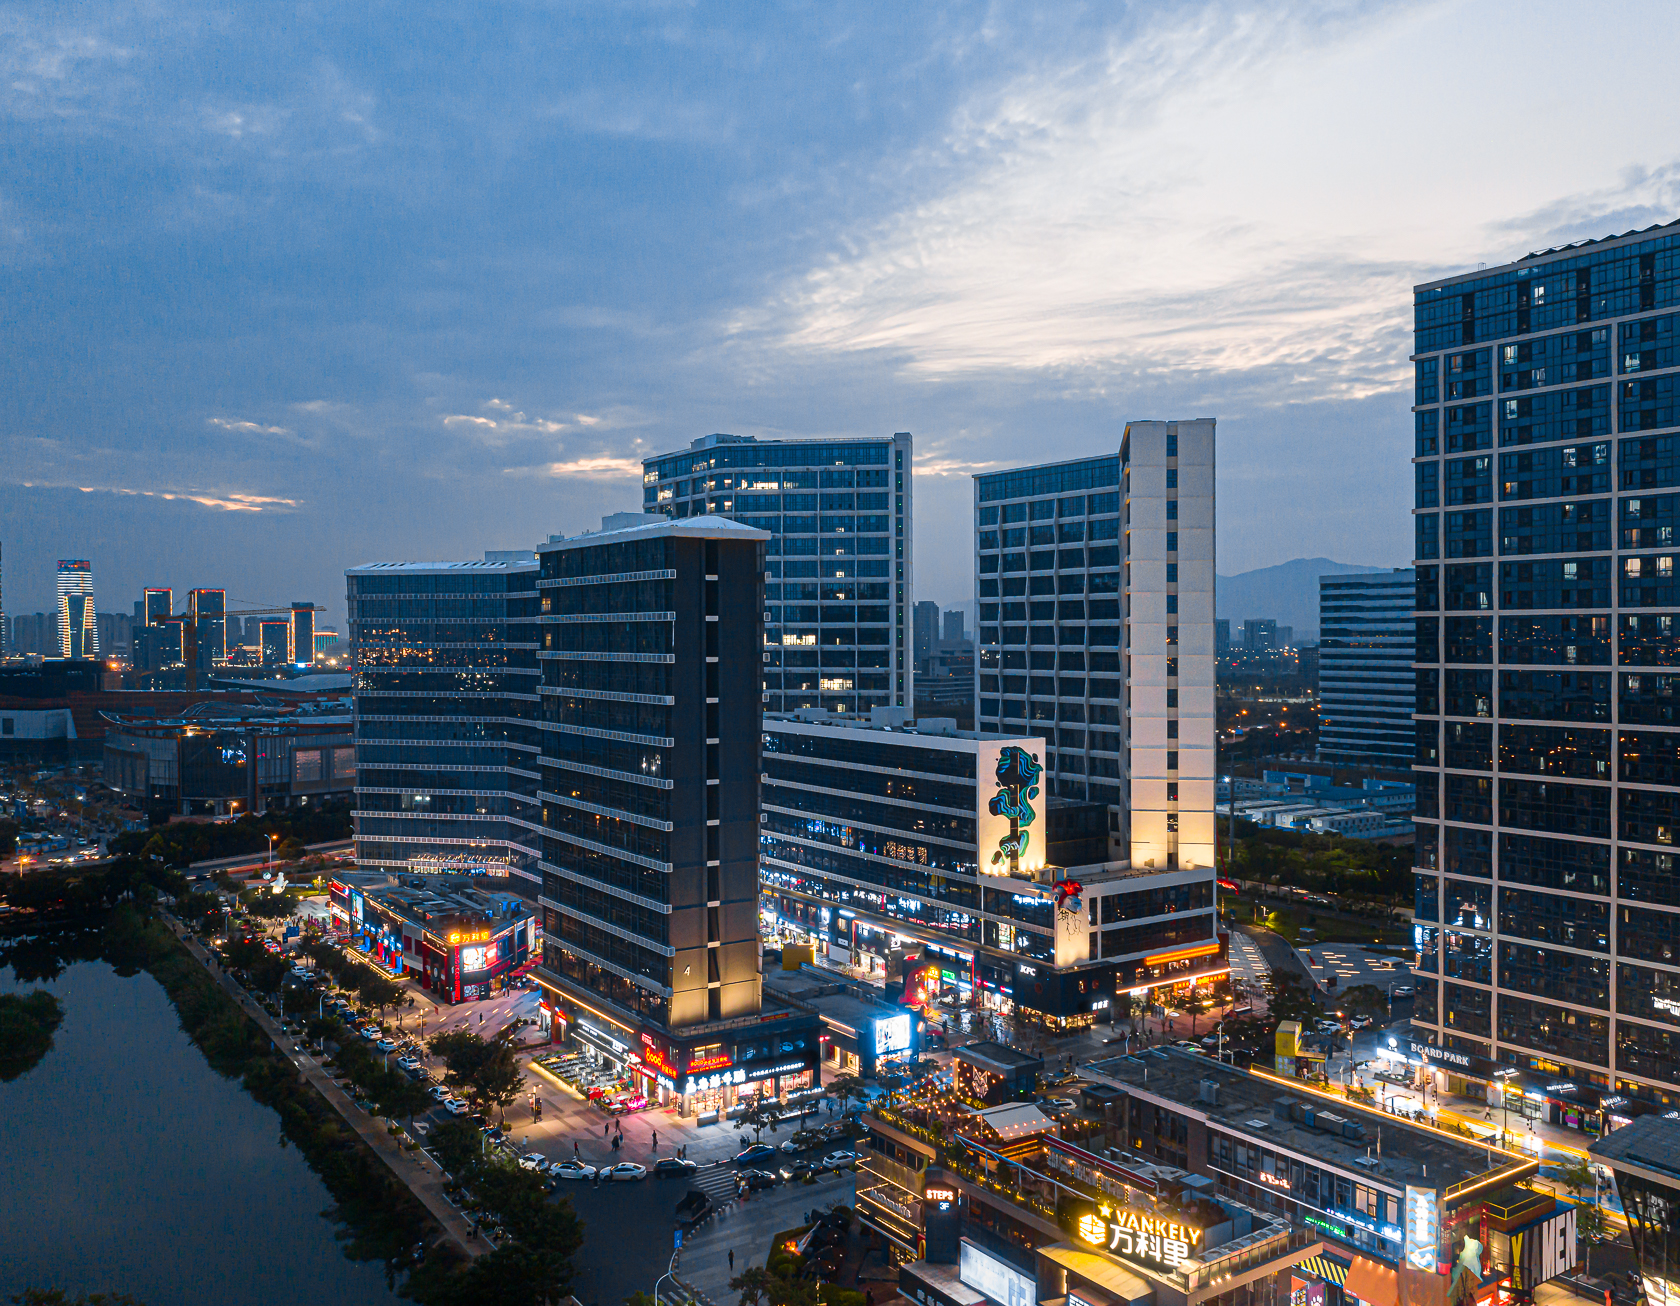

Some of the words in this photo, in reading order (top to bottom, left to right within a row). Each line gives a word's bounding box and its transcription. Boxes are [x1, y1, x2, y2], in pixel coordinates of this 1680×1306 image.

[684, 966, 691, 977] 4
[1020, 964, 1036, 976] KFC
[1410, 1042, 1442, 1059] BOARD
[1443, 1051, 1469, 1066] PARK
[926, 1189, 954, 1200] STEPS
[939, 1202, 950, 1211] 3F
[1115, 1210, 1200, 1246] VANKELY
[1109, 1223, 1189, 1267] 万科里
